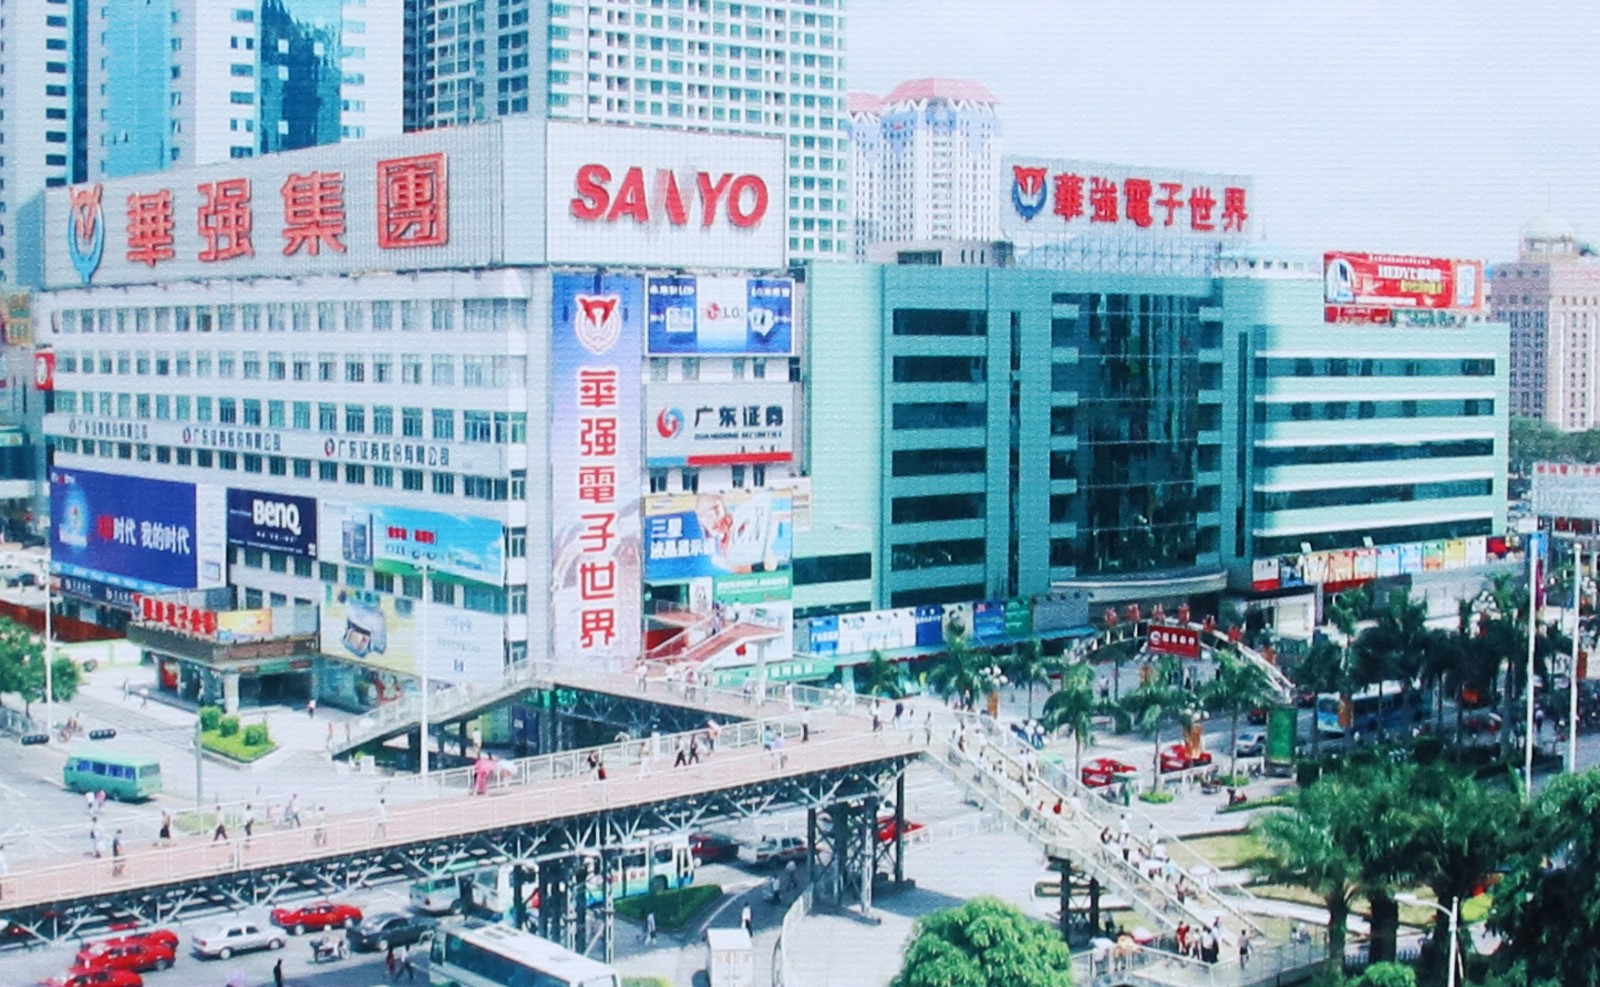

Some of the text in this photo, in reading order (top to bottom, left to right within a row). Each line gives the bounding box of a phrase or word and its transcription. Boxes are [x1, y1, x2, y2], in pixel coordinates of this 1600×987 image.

[570, 163, 769, 228] SANYO
[723, 306, 741, 319] LG
[694, 405, 784, 429] 广东证券
[252, 498, 302, 536] BenQ
